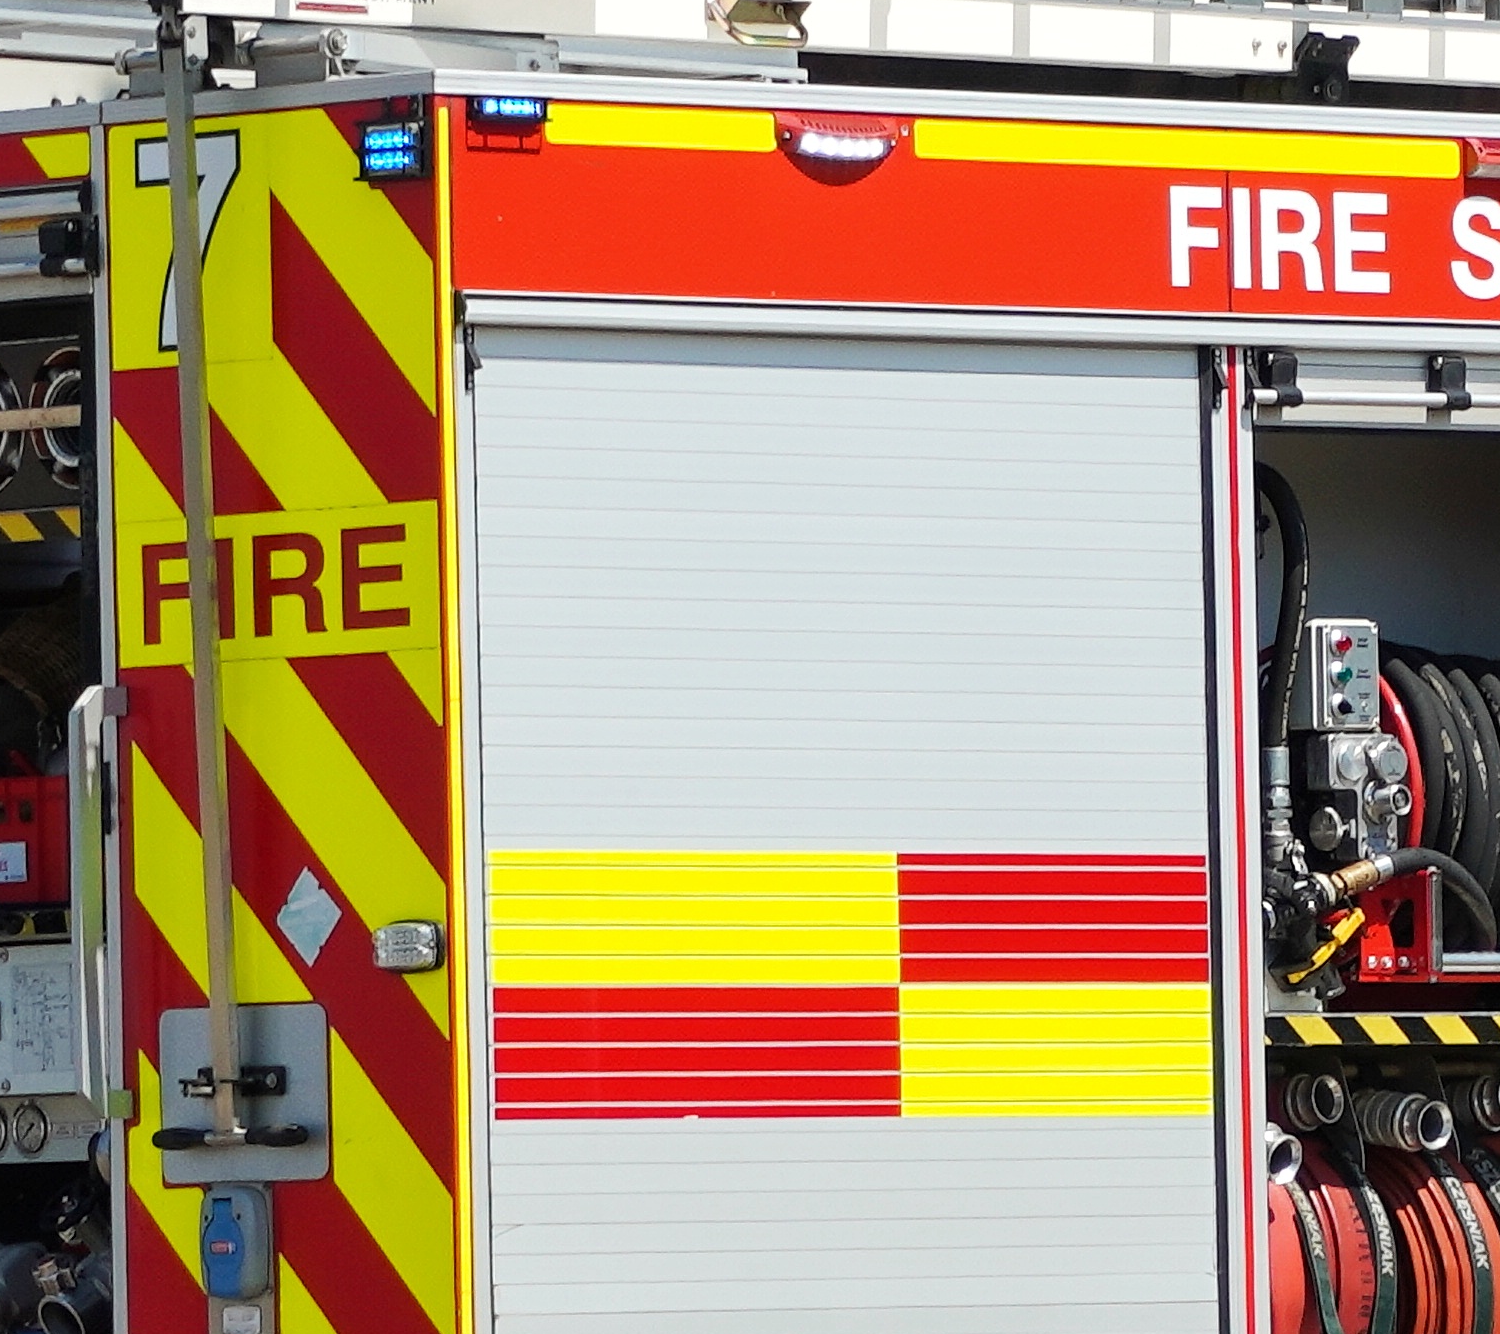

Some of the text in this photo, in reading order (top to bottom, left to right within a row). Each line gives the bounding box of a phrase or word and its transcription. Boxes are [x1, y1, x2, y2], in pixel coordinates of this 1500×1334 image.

[135, 129, 240, 353] 7
[1168, 184, 1392, 295] FIRE
[141, 524, 411, 646] FIRE
